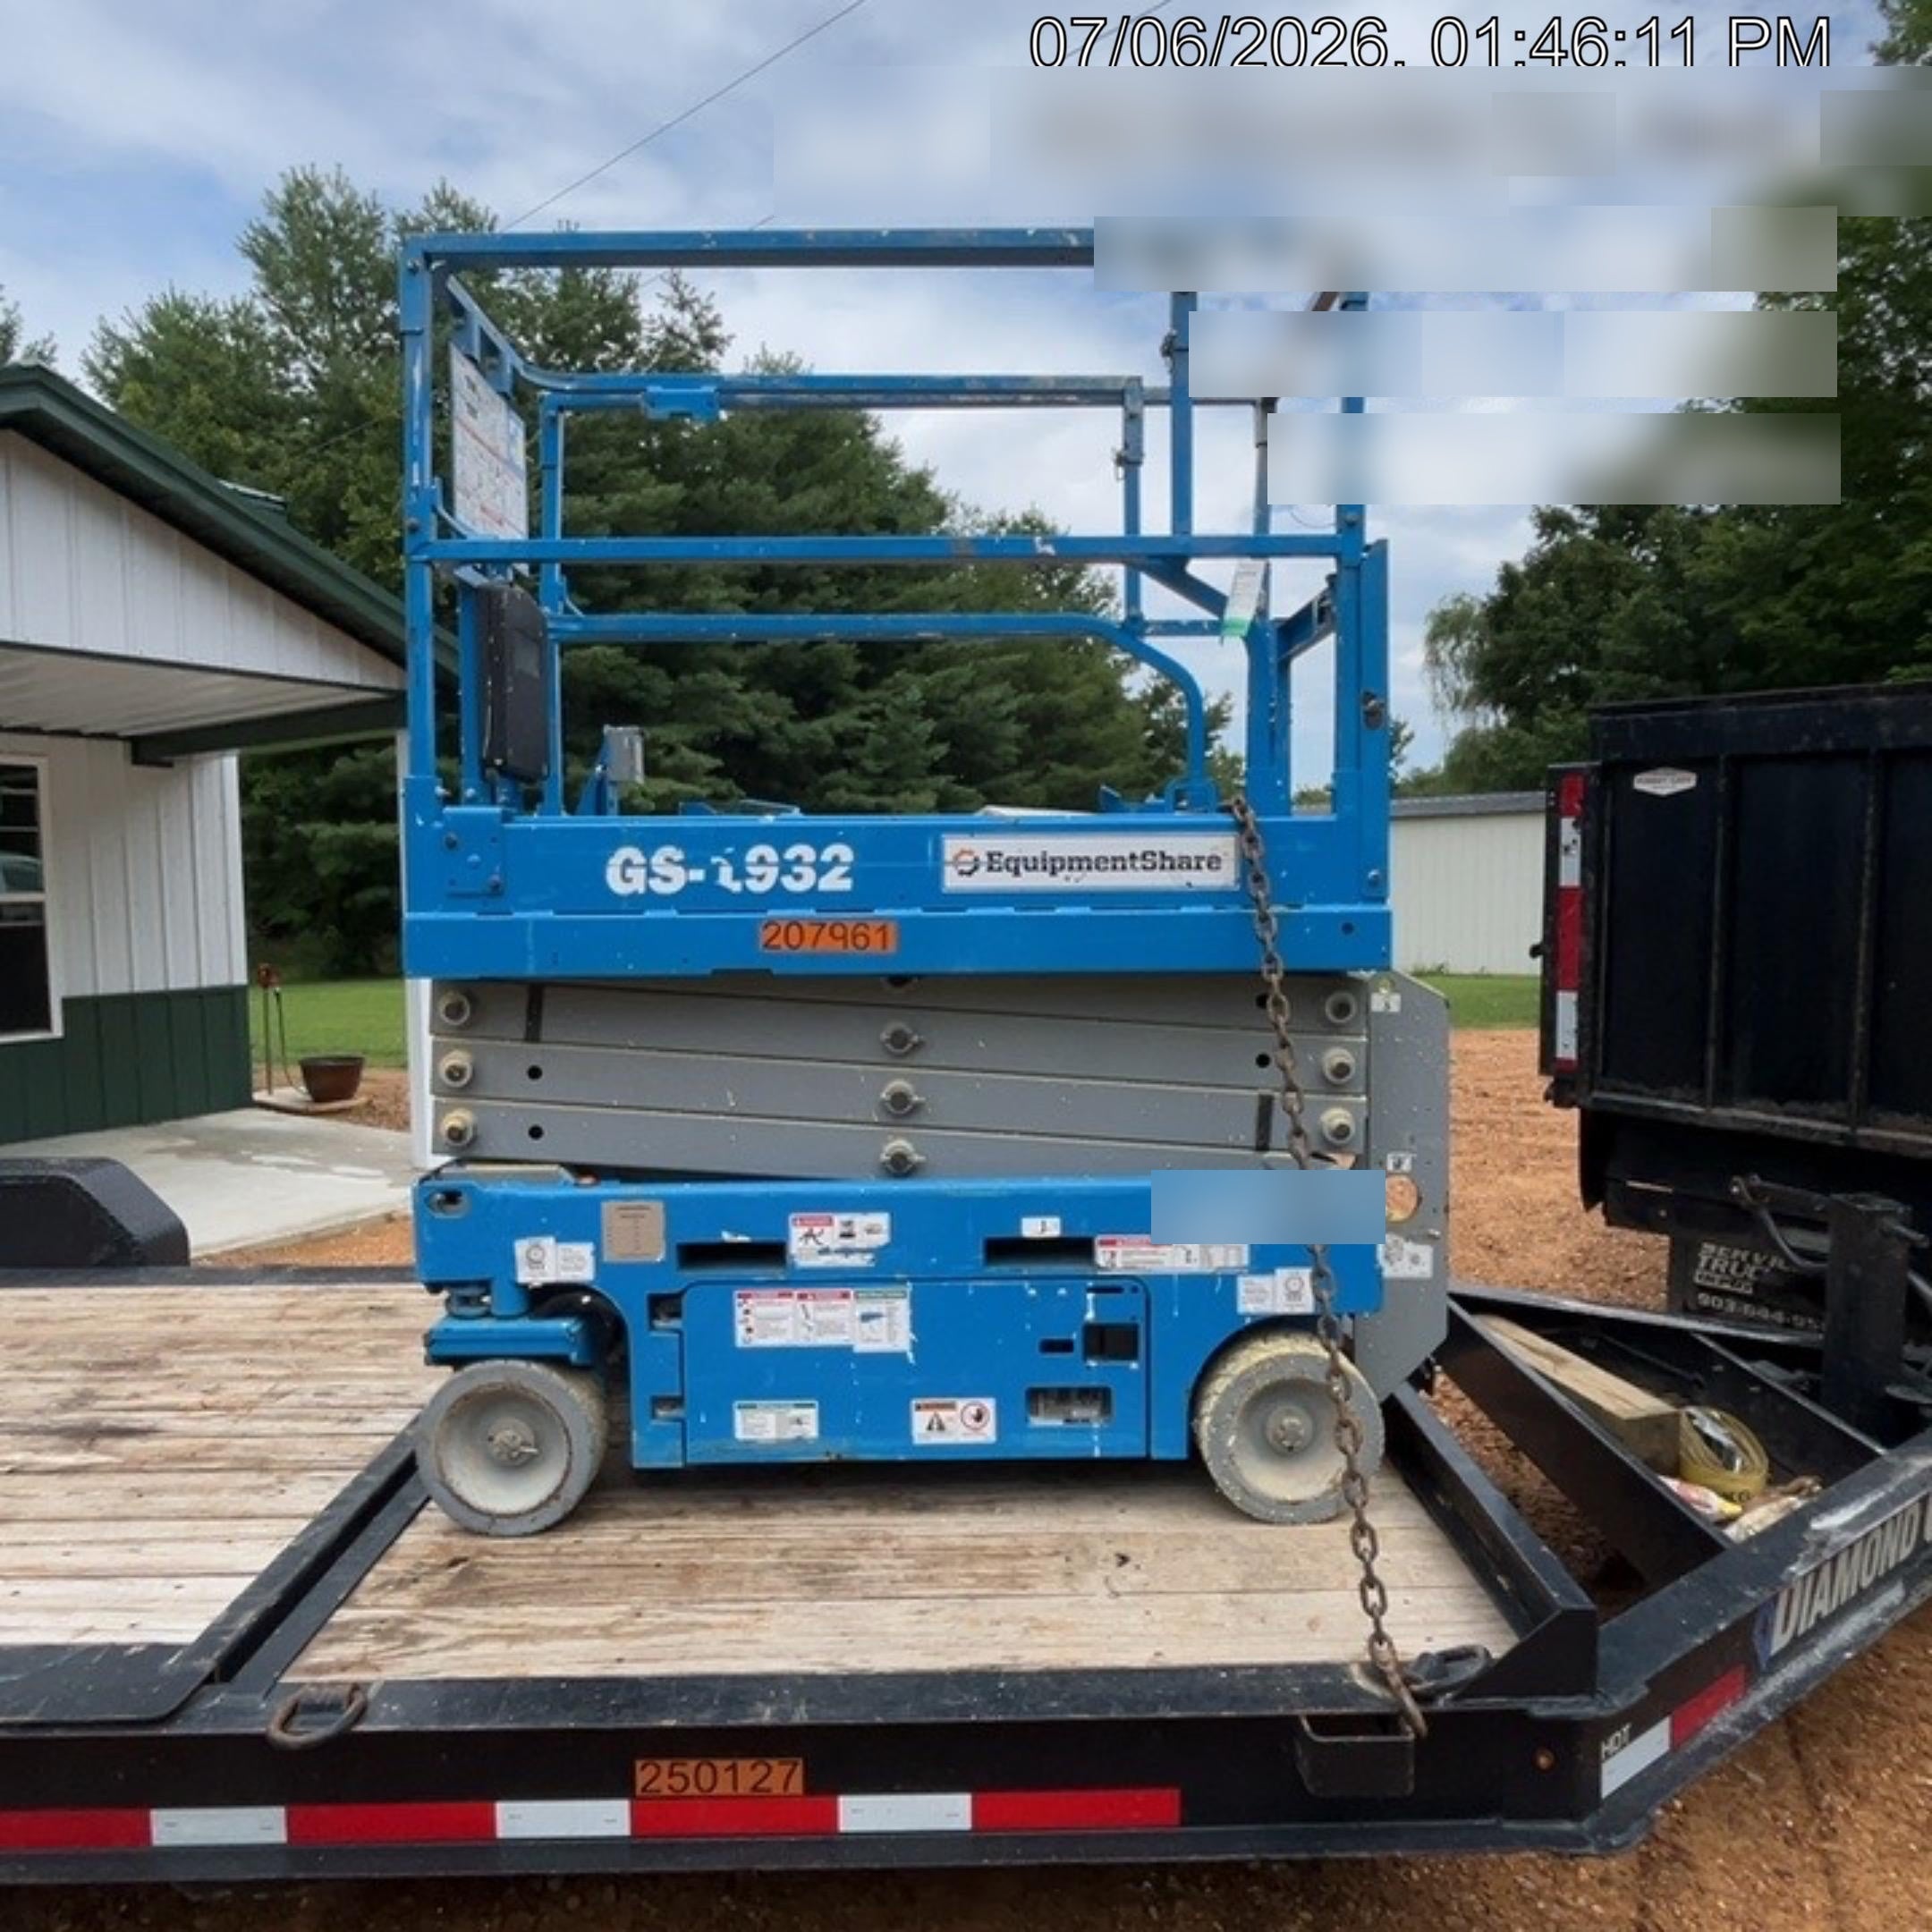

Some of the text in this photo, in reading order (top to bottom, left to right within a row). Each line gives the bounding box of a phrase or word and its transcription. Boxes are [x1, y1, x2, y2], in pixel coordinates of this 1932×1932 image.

[985, 851, 1223, 877] EquipmentShare
[760, 921, 891, 952] 207961
[1770, 1501, 1920, 1656] DIAMOND
[640, 1760, 799, 1793] 250127
